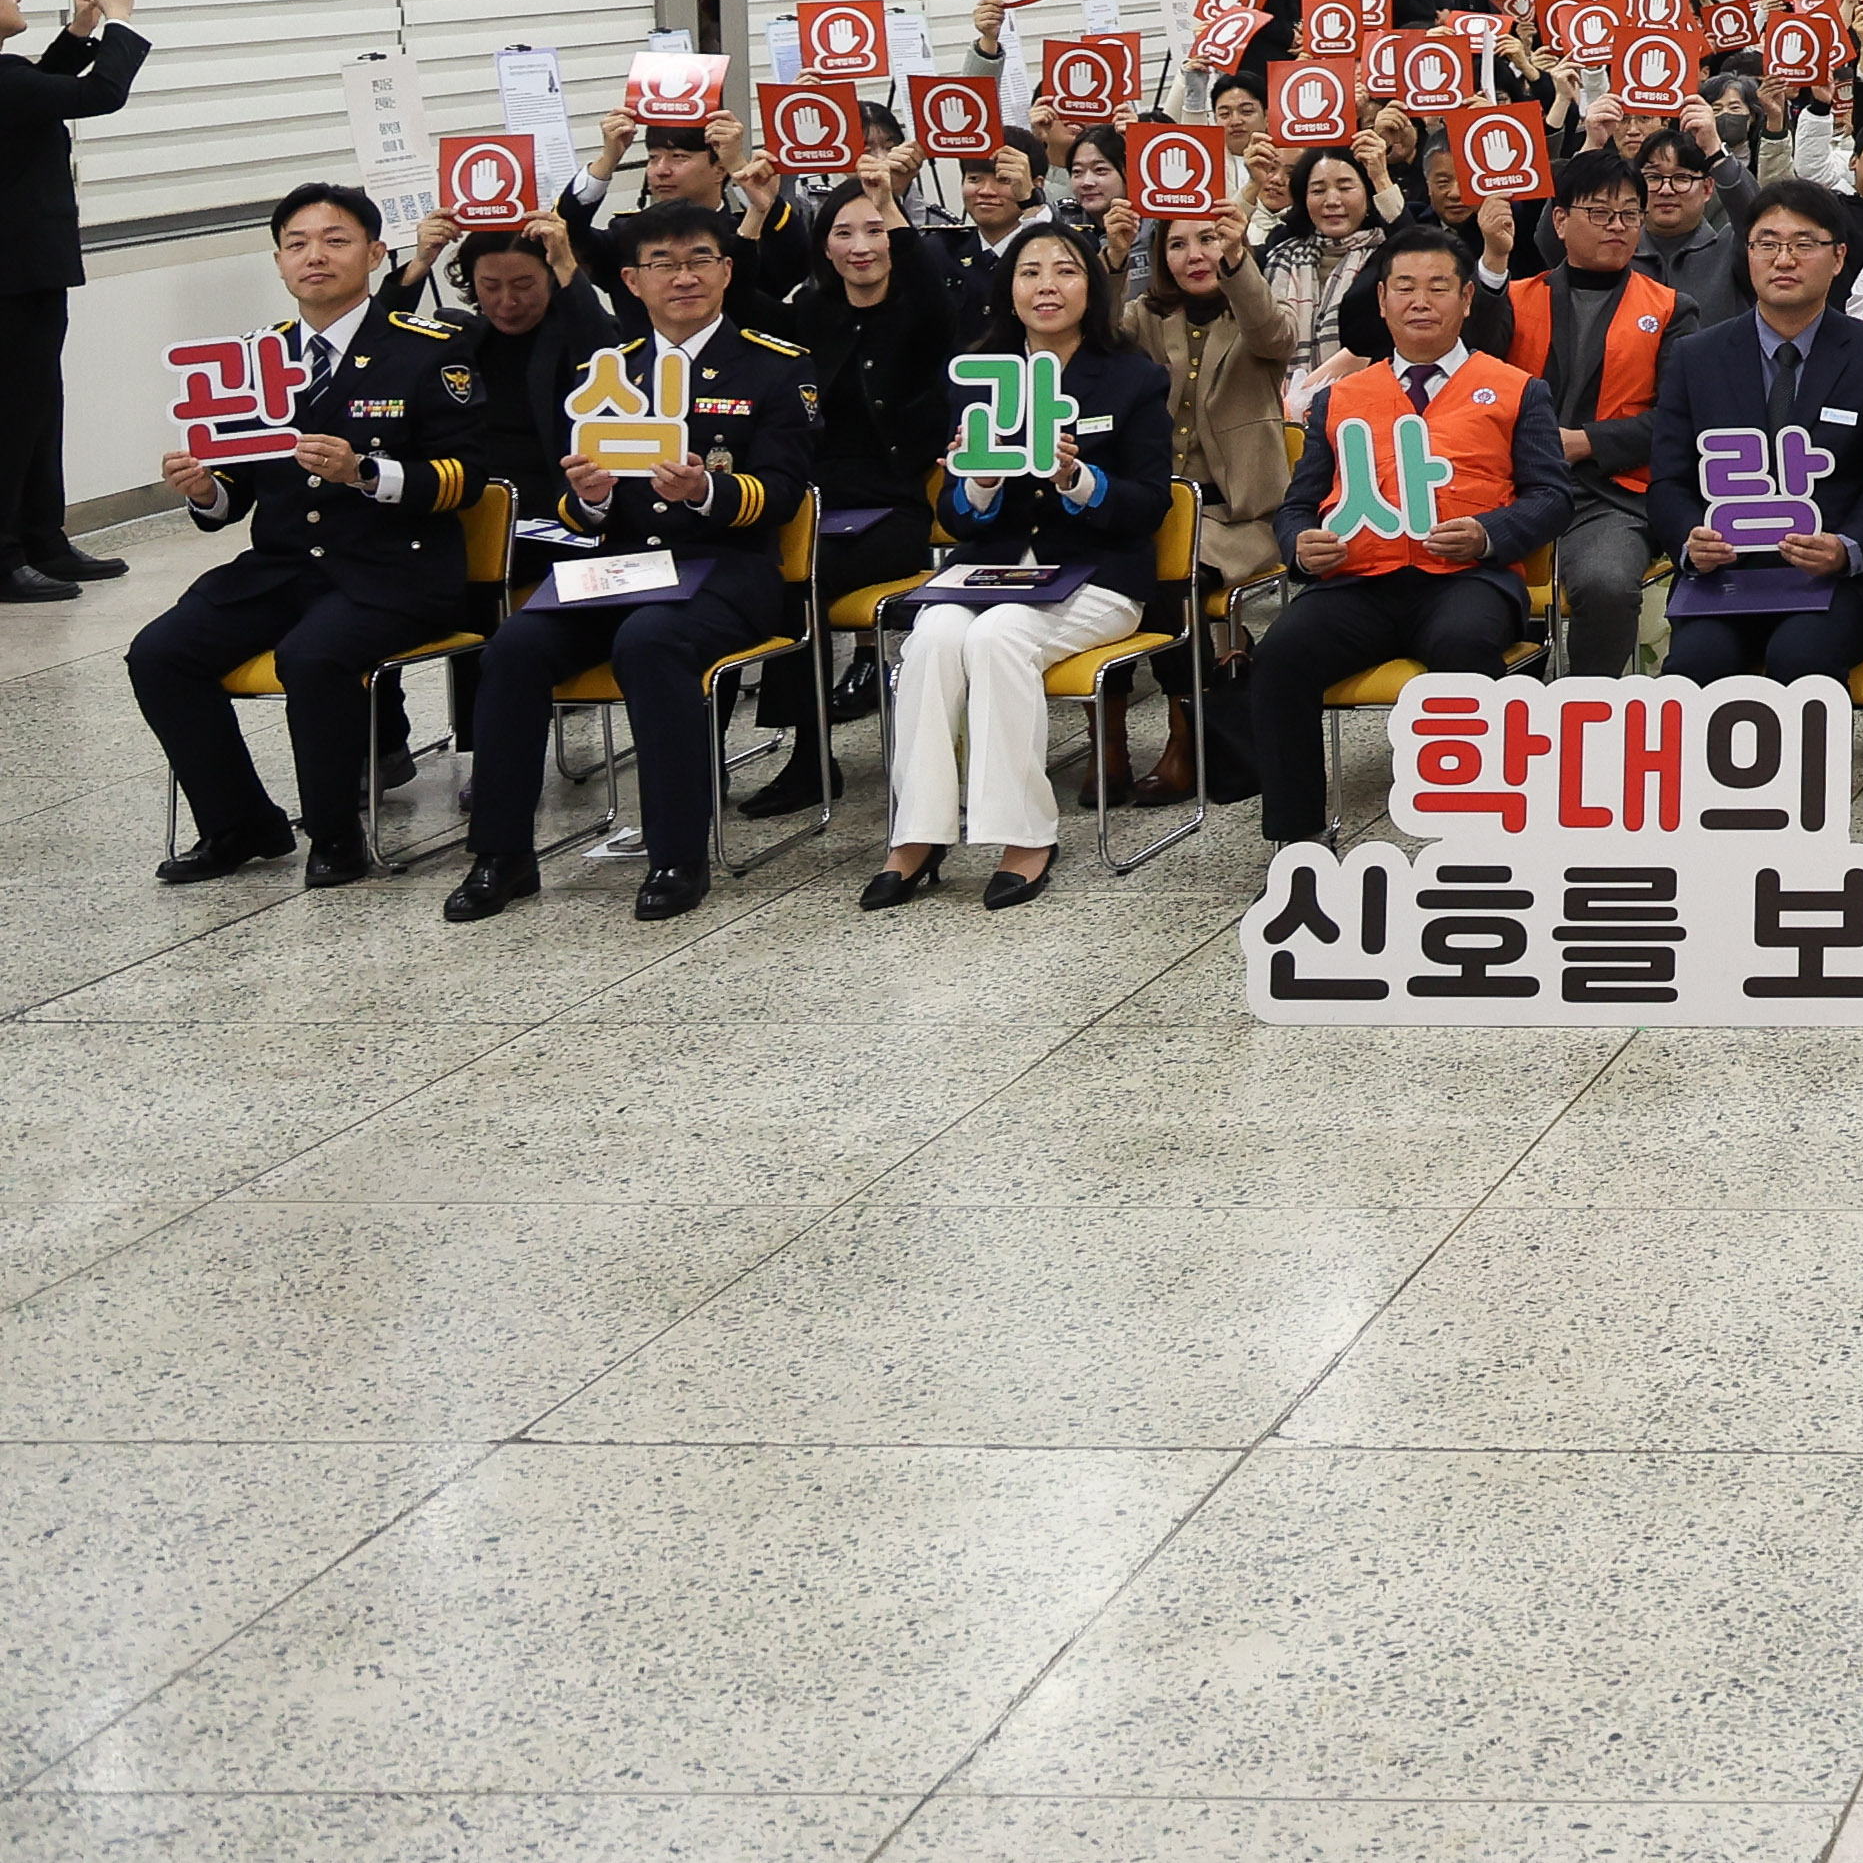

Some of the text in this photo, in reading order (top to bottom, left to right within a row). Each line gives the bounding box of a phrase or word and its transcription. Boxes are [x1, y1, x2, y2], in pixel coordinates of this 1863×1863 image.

[166, 334, 312, 466] 관
[570, 350, 688, 474] 심
[954, 354, 1076, 475] 과
[1325, 416, 1451, 540] 사
[1701, 427, 1835, 551] 랑
[1411, 697, 1829, 834] 학대의
[1262, 864, 1687, 1004] 신호를
